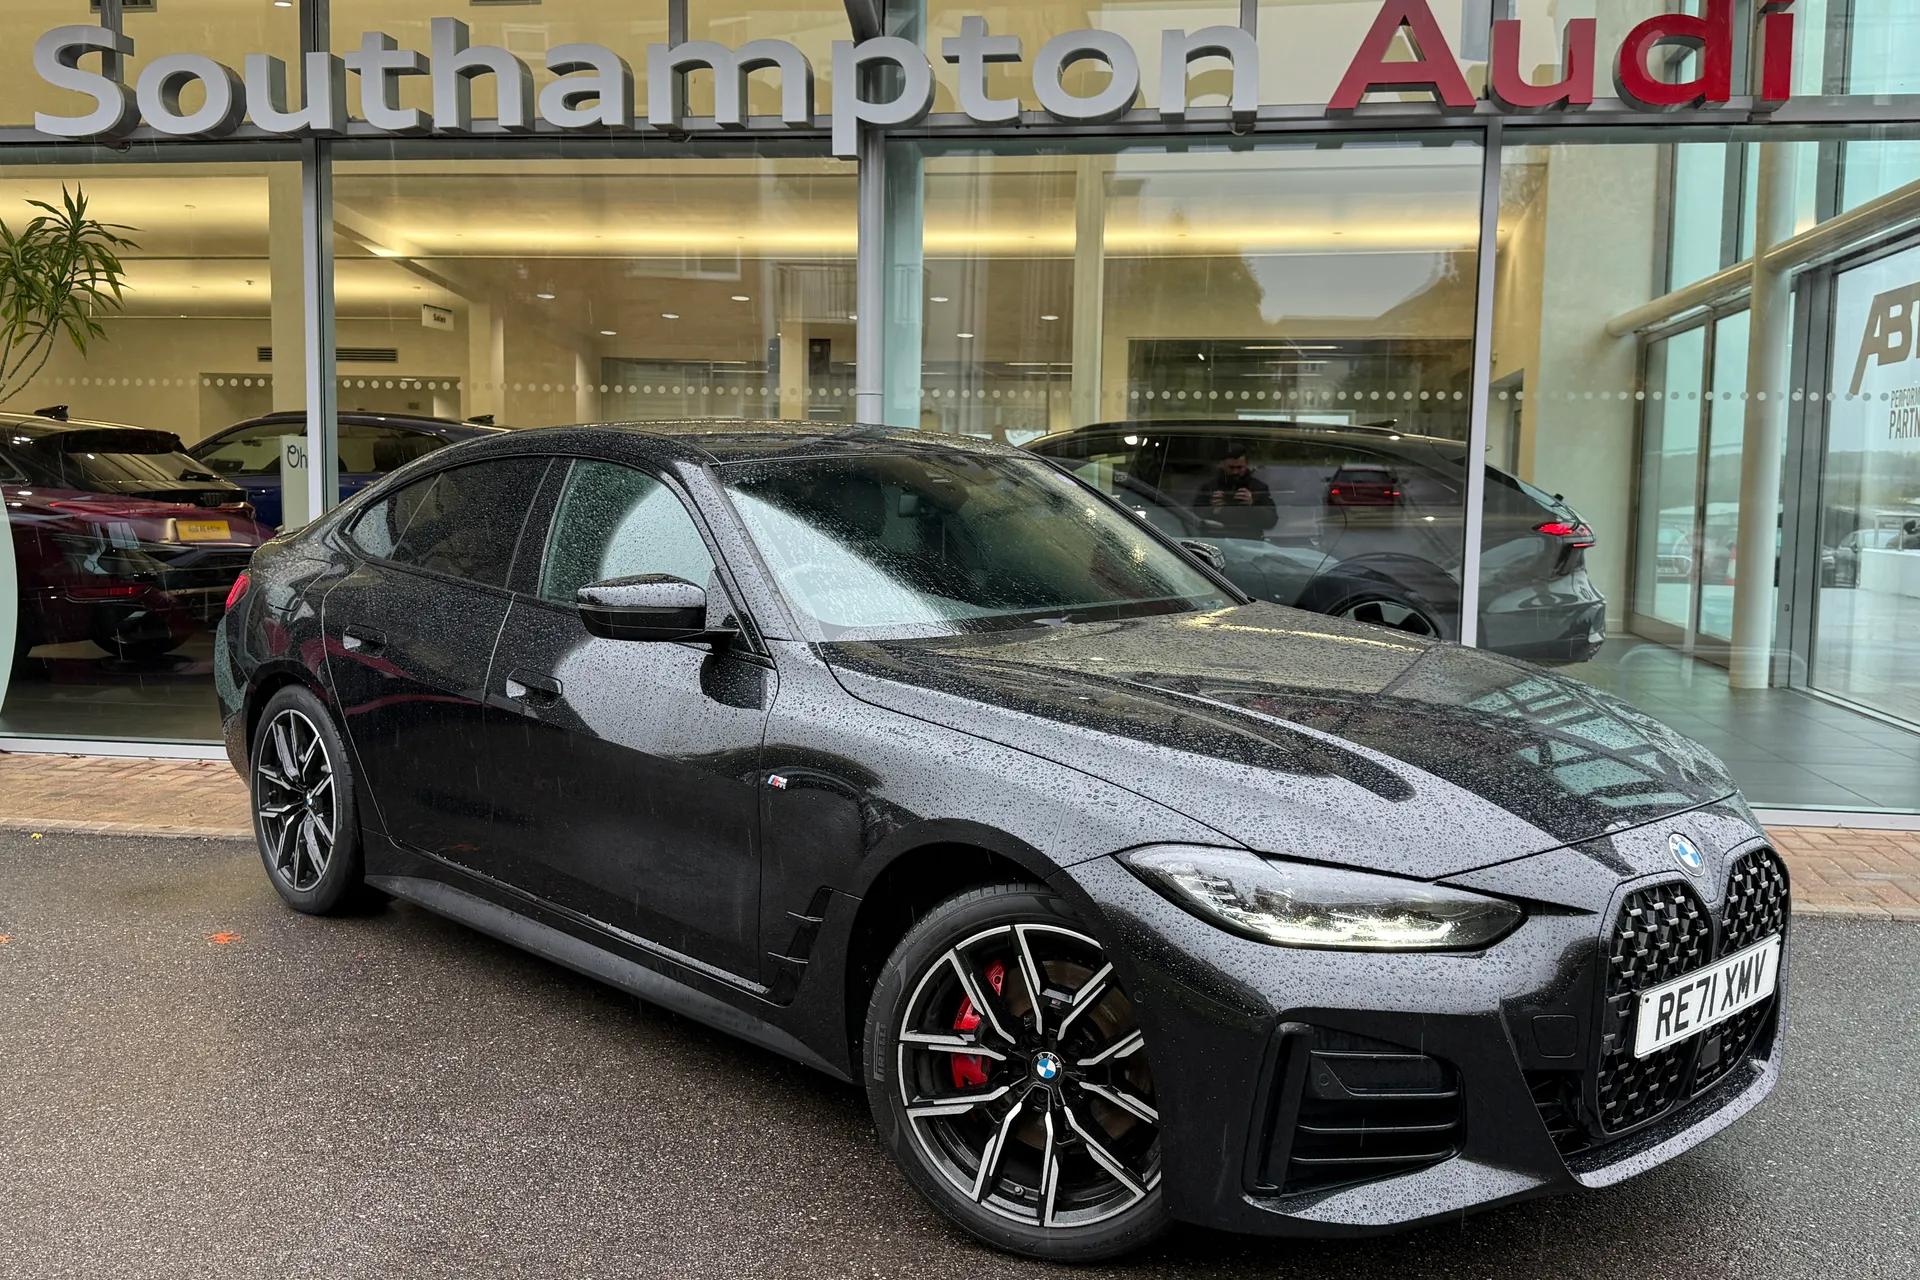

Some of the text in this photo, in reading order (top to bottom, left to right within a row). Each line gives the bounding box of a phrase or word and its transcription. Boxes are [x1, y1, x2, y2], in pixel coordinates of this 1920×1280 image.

[33, 0, 1795, 158] Southampton Audi
[1849, 281, 1920, 396] AB
[1655, 949, 1767, 1041] RE71 XMV
